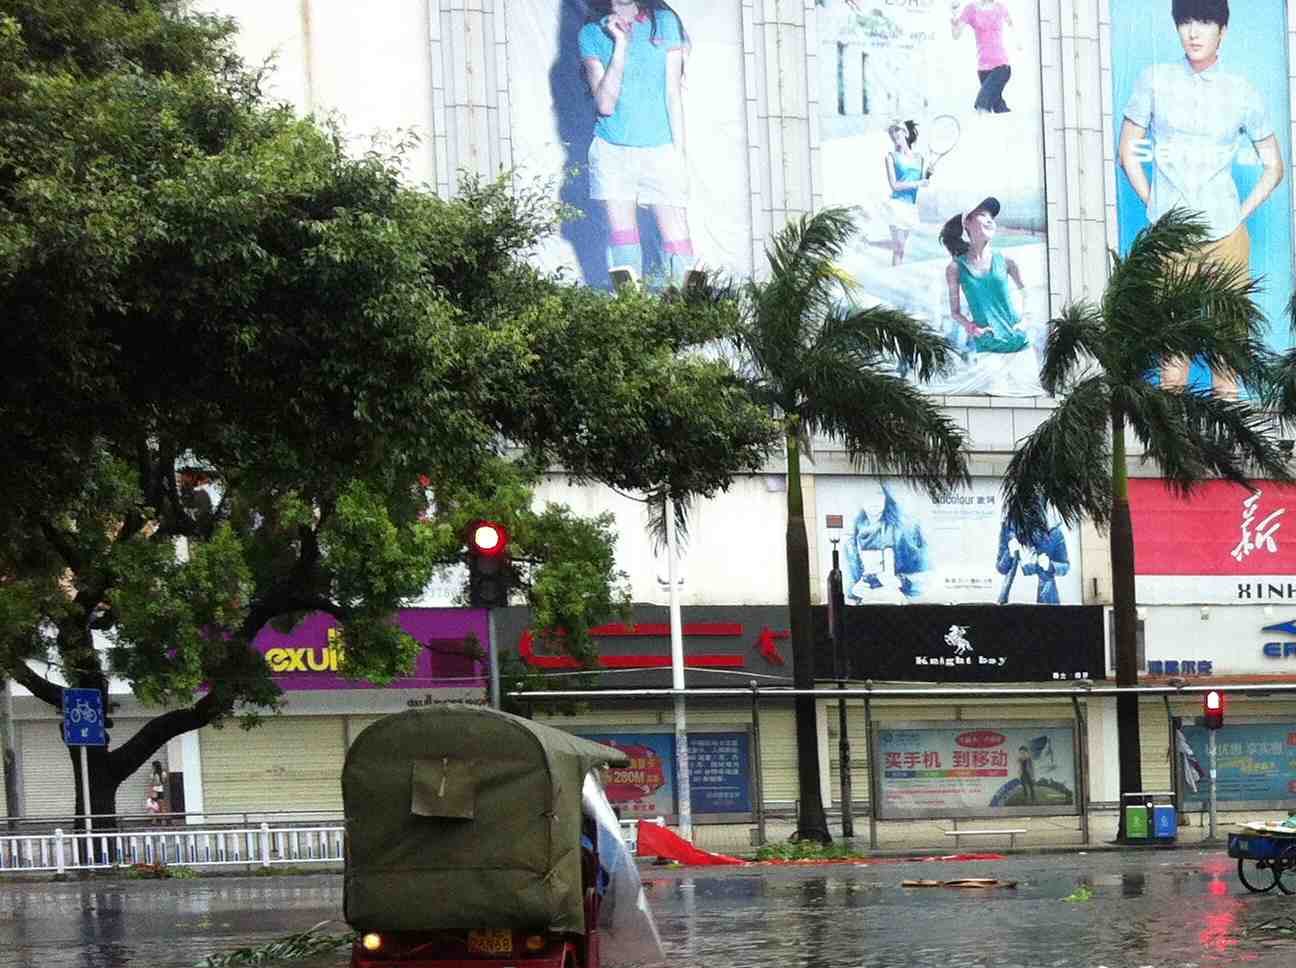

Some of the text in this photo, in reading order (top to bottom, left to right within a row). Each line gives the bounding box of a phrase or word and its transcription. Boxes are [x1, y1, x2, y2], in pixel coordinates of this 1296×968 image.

[885, 750, 1008, 769] 买手机 到移动
